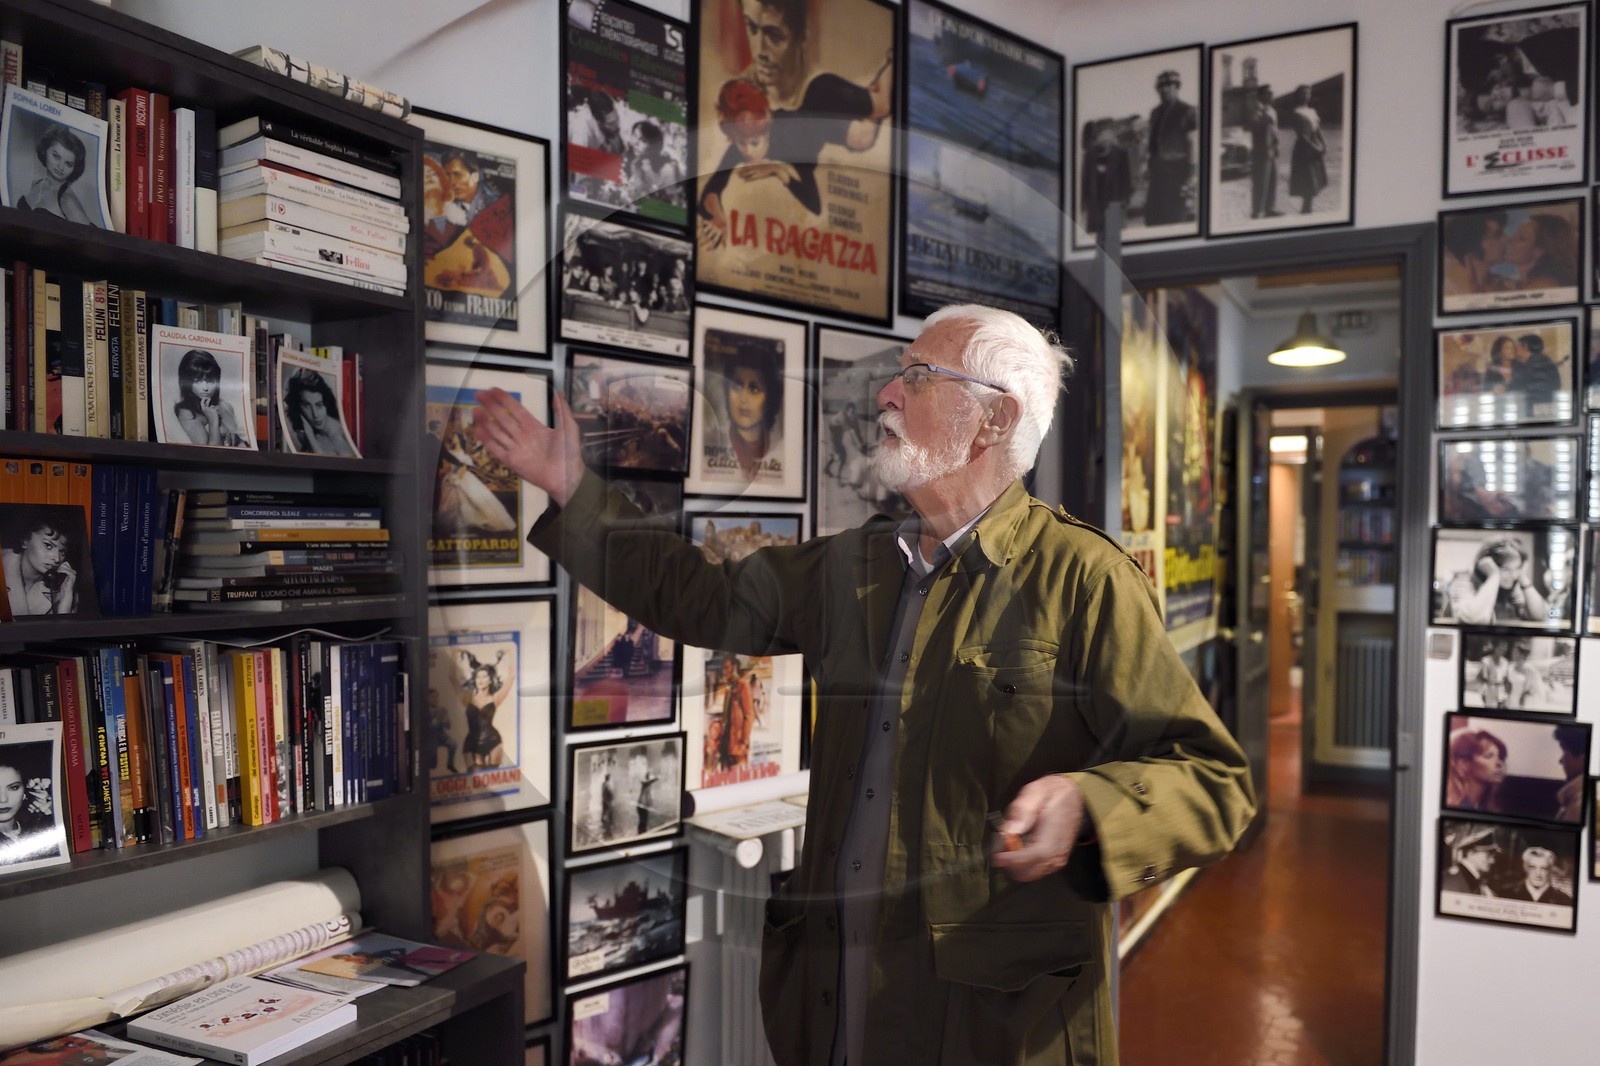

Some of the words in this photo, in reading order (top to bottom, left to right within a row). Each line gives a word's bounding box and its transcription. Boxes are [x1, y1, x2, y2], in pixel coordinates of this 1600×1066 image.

[13, 92, 38, 107] SOPHIA
[40, 102, 62, 116] LOREN
[136, 96, 146, 126] VISCONTI
[114, 144, 120, 152] La
[136, 128, 145, 157] LUCHINO
[290, 130, 298, 138] La
[300, 134, 323, 148] véritable
[324, 141, 342, 153] Sophia
[344, 146, 360, 160] Loren
[1466, 155, 1480, 168] L'
[1484, 146, 1569, 170] ECLISSE
[314, 184, 336, 196] FELLINI
[730, 208, 759, 248] LA
[765, 216, 878, 276] RAGAZZA
[345, 254, 371, 271] Fellini
[108, 284, 120, 327] FELLINI
[136, 297, 146, 335] FELLINI
[96, 308, 106, 341] FELLINI
[159, 330, 187, 341] CLAUDIA
[188, 334, 222, 346] CARDINALE
[140, 392, 146, 400] LA
[121, 502, 129, 532] Western
[240, 510, 280, 518] CONCORRENZA
[426, 538, 519, 552] GATTOPARDO
[140, 545, 148, 572] Cinéma
[227, 591, 258, 600] TRUFFAUT
[260, 590, 288, 598] L'UOMO
[334, 586, 356, 594] CINEMA
[43, 674, 52, 698] Marjorie
[65, 680, 75, 722] DIZIONARIO
[70, 738, 79, 767] CINEMA
[116, 714, 127, 740] L'AMERICA
[211, 710, 221, 729] ELIA
[212, 729, 223, 756] KAZAN
[98, 735, 108, 766] CINEMA
[104, 780, 112, 813] FUMETTI
[119, 752, 130, 781] WESTERN
[473, 768, 520, 789] DOMANI
